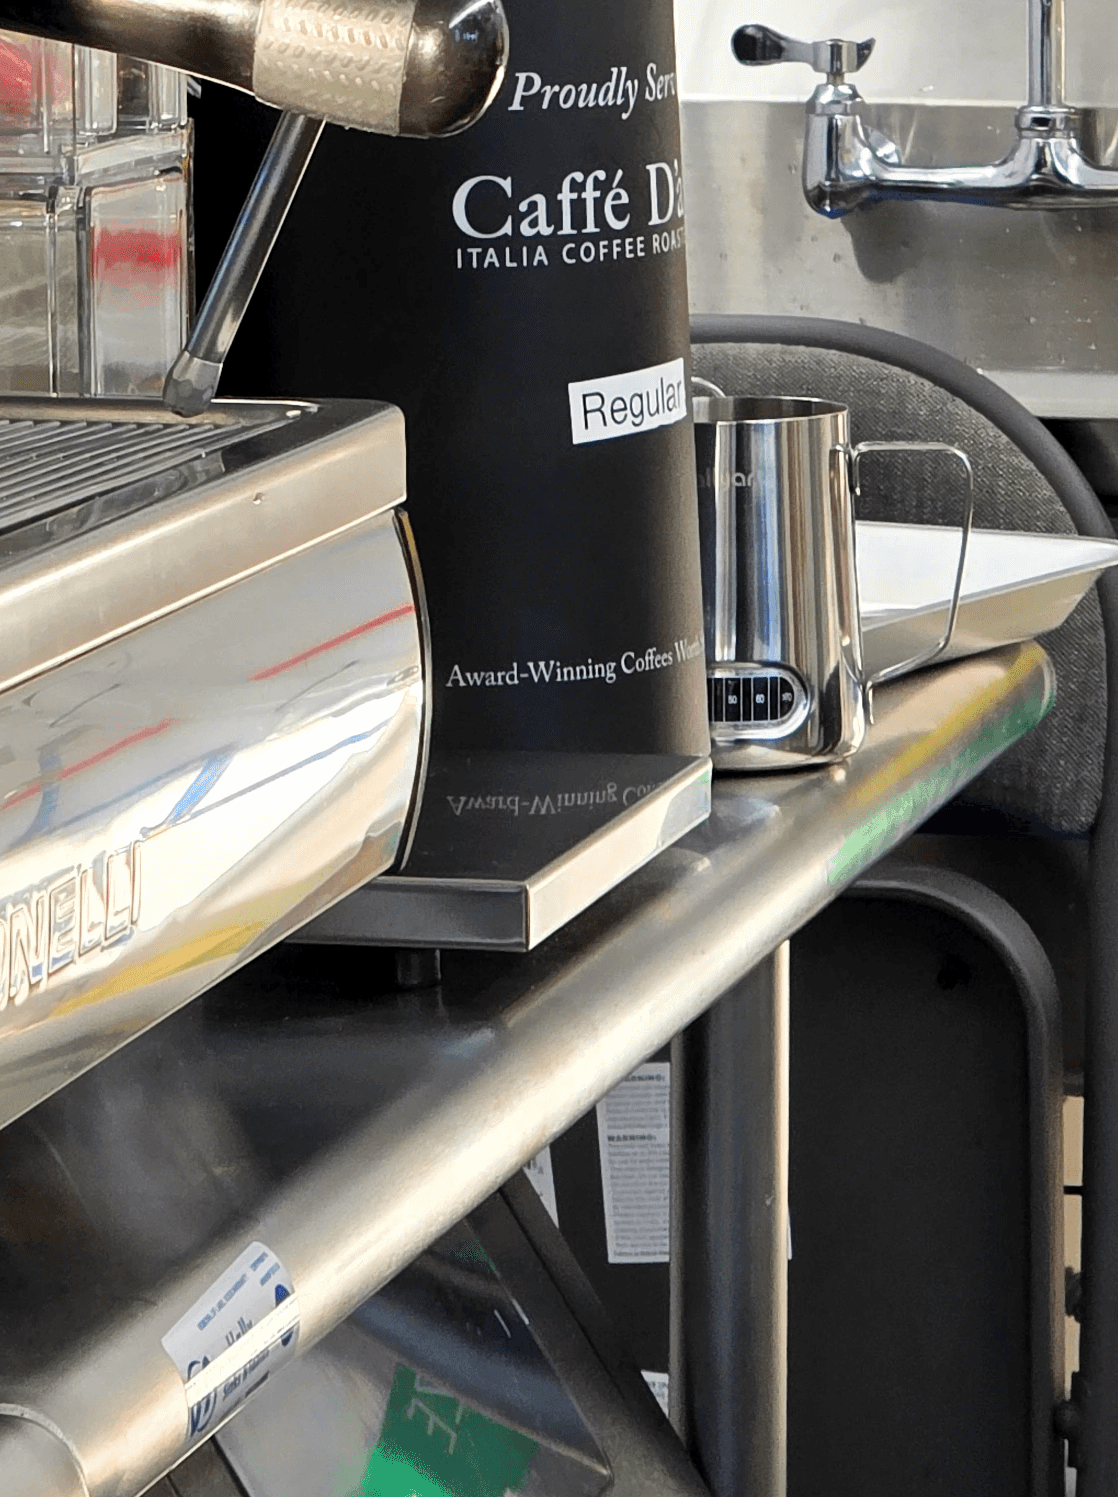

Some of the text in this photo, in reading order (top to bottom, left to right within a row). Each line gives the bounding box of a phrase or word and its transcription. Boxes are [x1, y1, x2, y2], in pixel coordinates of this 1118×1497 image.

[508, 66, 638, 120] Proudly
[452, 168, 630, 239] Caffé
[456, 245, 549, 269] ITALIA
[561, 236, 646, 265] COFFEE
[582, 376, 682, 430] Regular
[445, 657, 617, 688] Award-Winning
[621, 646, 674, 675] Coffees
